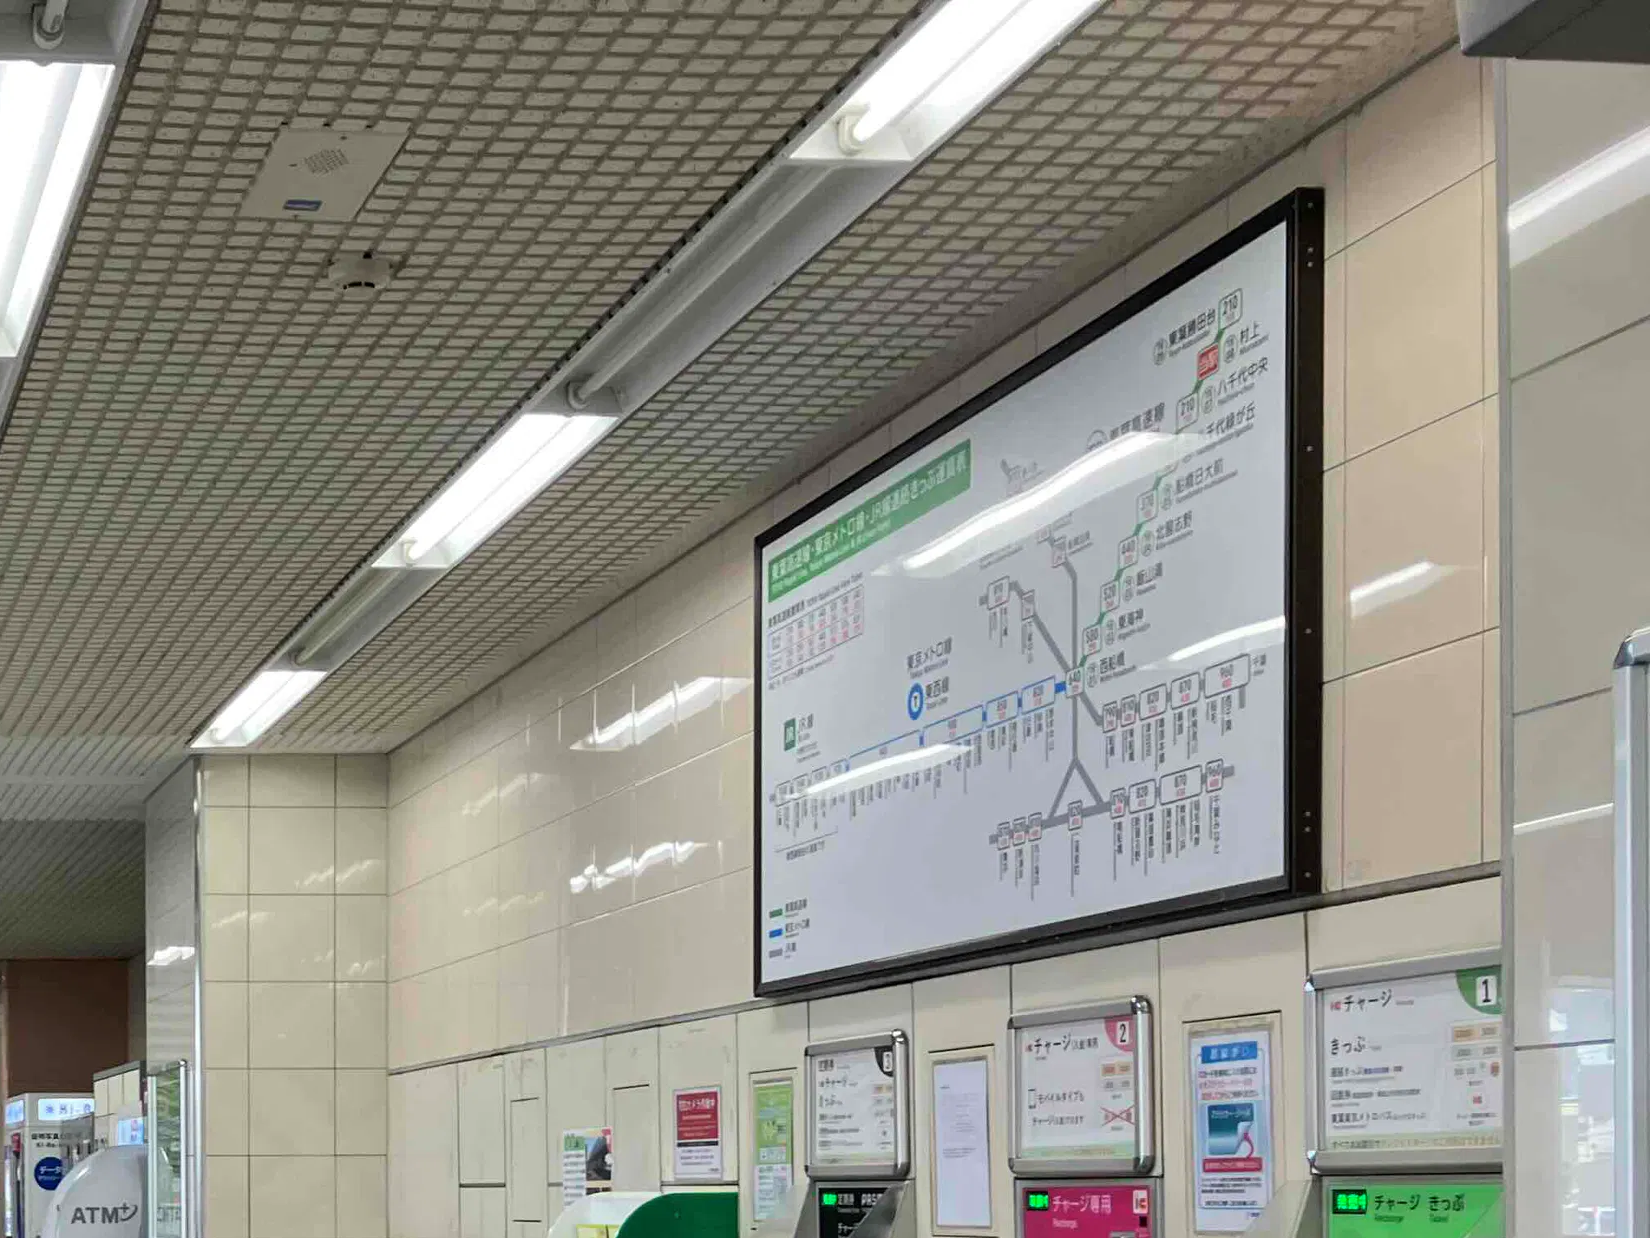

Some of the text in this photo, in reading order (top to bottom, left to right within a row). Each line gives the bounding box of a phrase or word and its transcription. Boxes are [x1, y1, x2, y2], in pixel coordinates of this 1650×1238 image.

[1481, 978, 1493, 1004] 1
[1343, 989, 1392, 1013] チャージ
[1119, 1023, 1127, 1042] 2
[1331, 1036, 1366, 1055] きっぷ
[1374, 1194, 1421, 1211] チャージ
[1429, 1193, 1465, 1212] きっぷ
